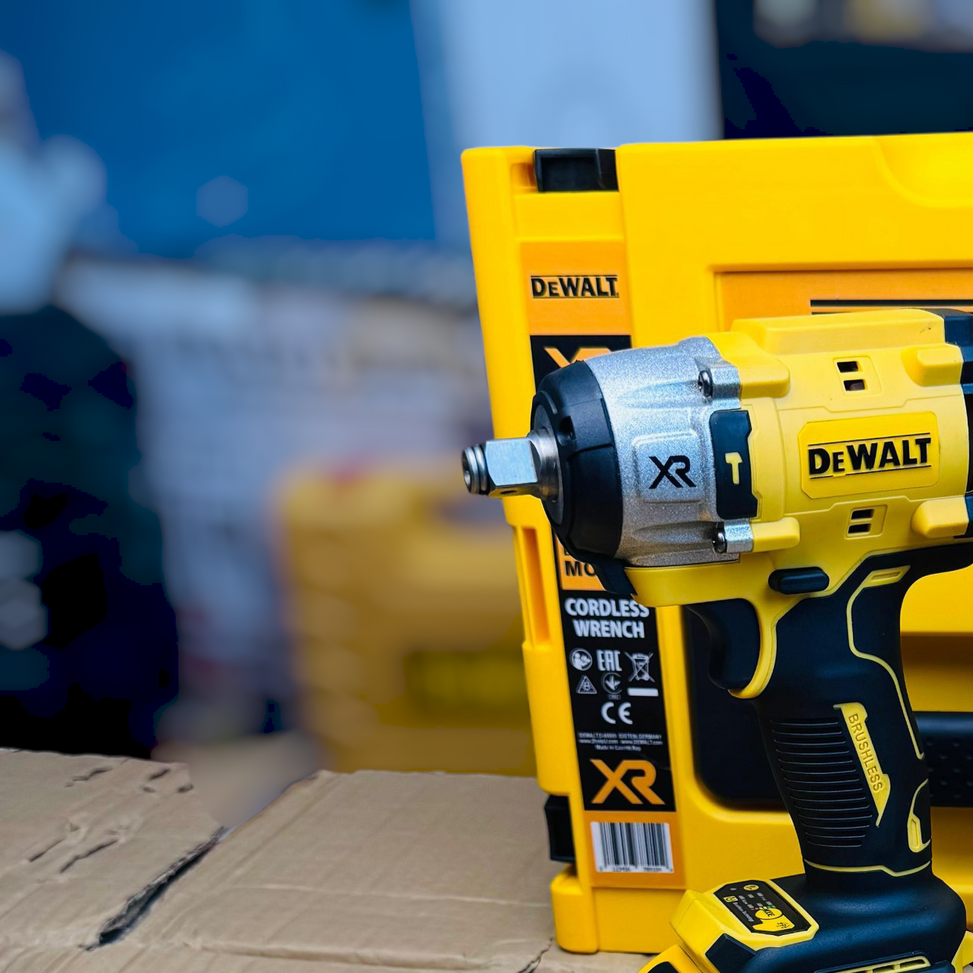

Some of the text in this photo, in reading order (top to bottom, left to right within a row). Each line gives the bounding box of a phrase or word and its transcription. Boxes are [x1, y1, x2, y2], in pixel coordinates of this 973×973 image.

[530, 276, 618, 298] DEWALT
[808, 438, 931, 476] DEWALT
[649, 455, 696, 489] XR
[564, 597, 650, 618] CORDLESS
[572, 619, 645, 639] WRENCH
[601, 702, 633, 725] CE
[848, 712, 883, 792] BRUSHLESS
[589, 759, 666, 805] XR
